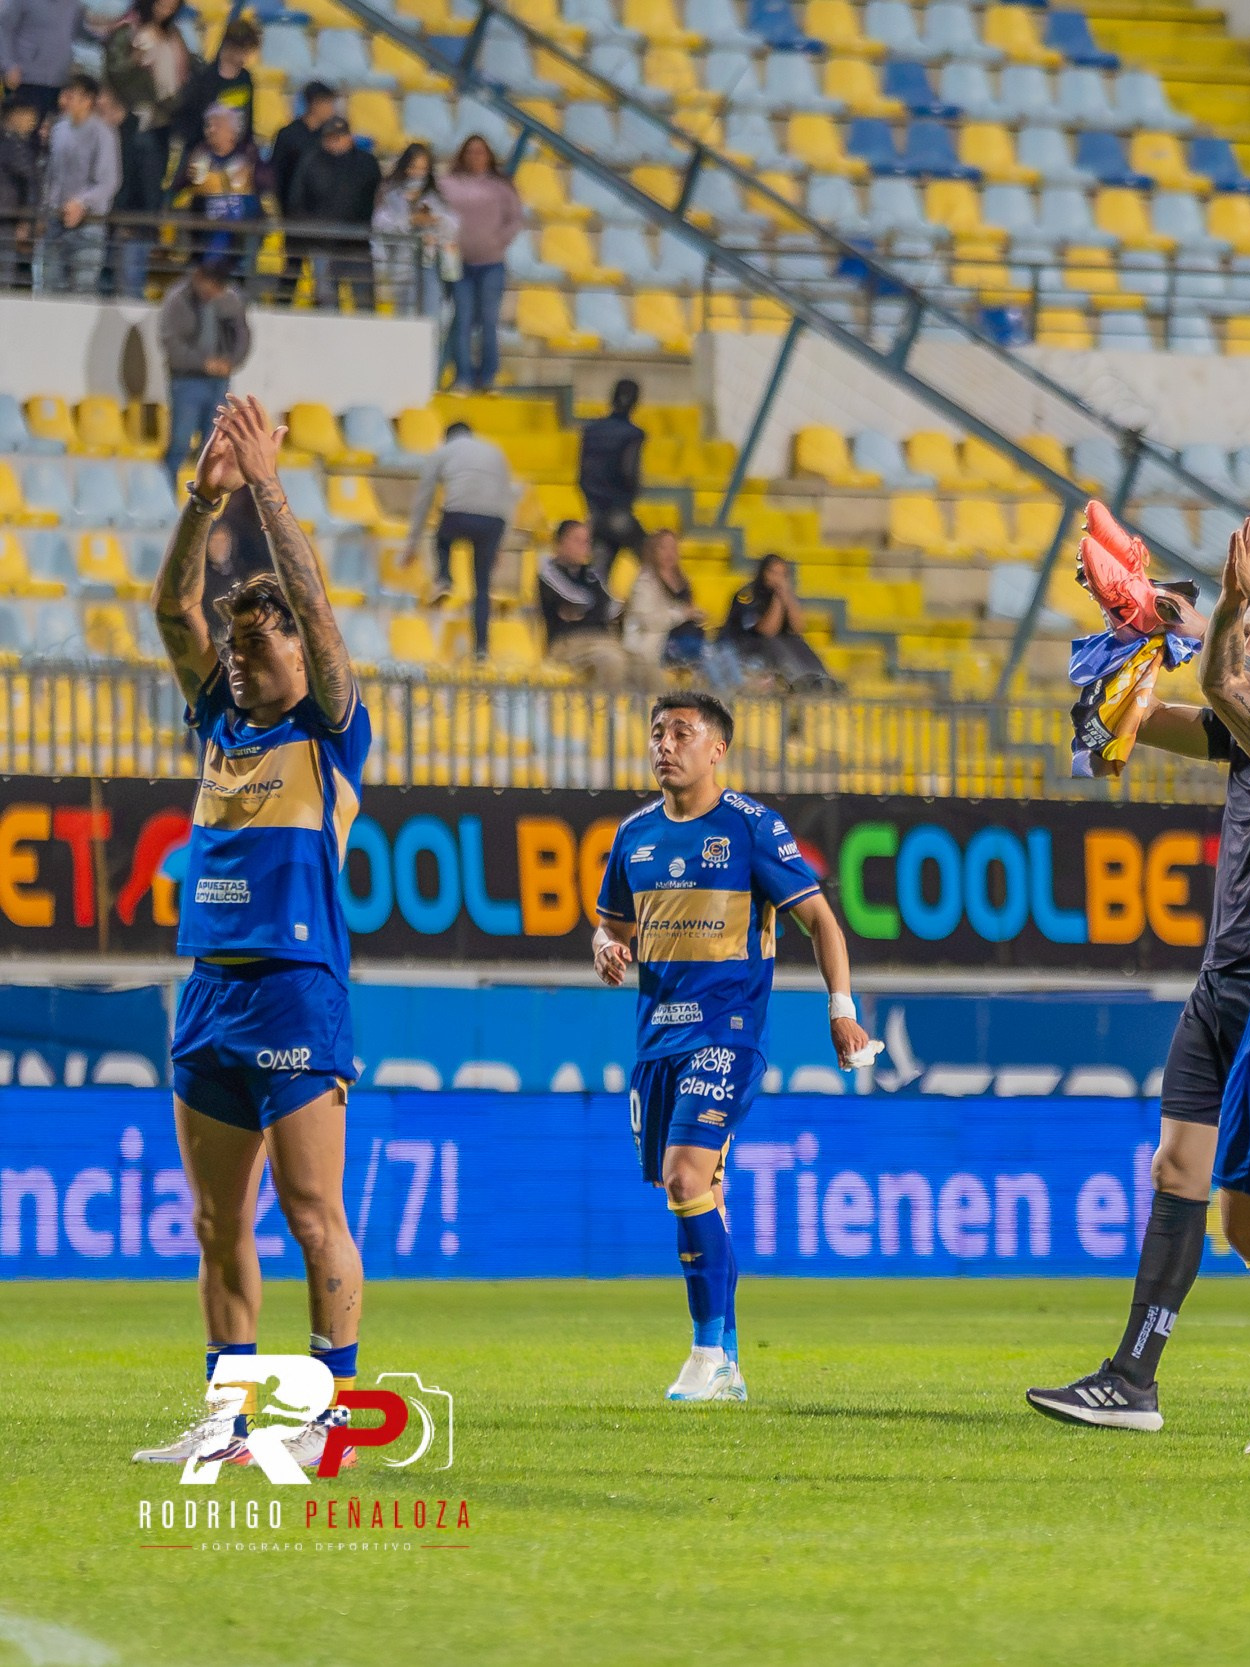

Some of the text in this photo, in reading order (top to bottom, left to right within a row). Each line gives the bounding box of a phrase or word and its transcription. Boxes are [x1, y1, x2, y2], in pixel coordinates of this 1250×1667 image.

[723, 793, 762, 816] Claro
[839, 822, 1222, 947] COOLBE
[680, 1077, 734, 1101] Claro
